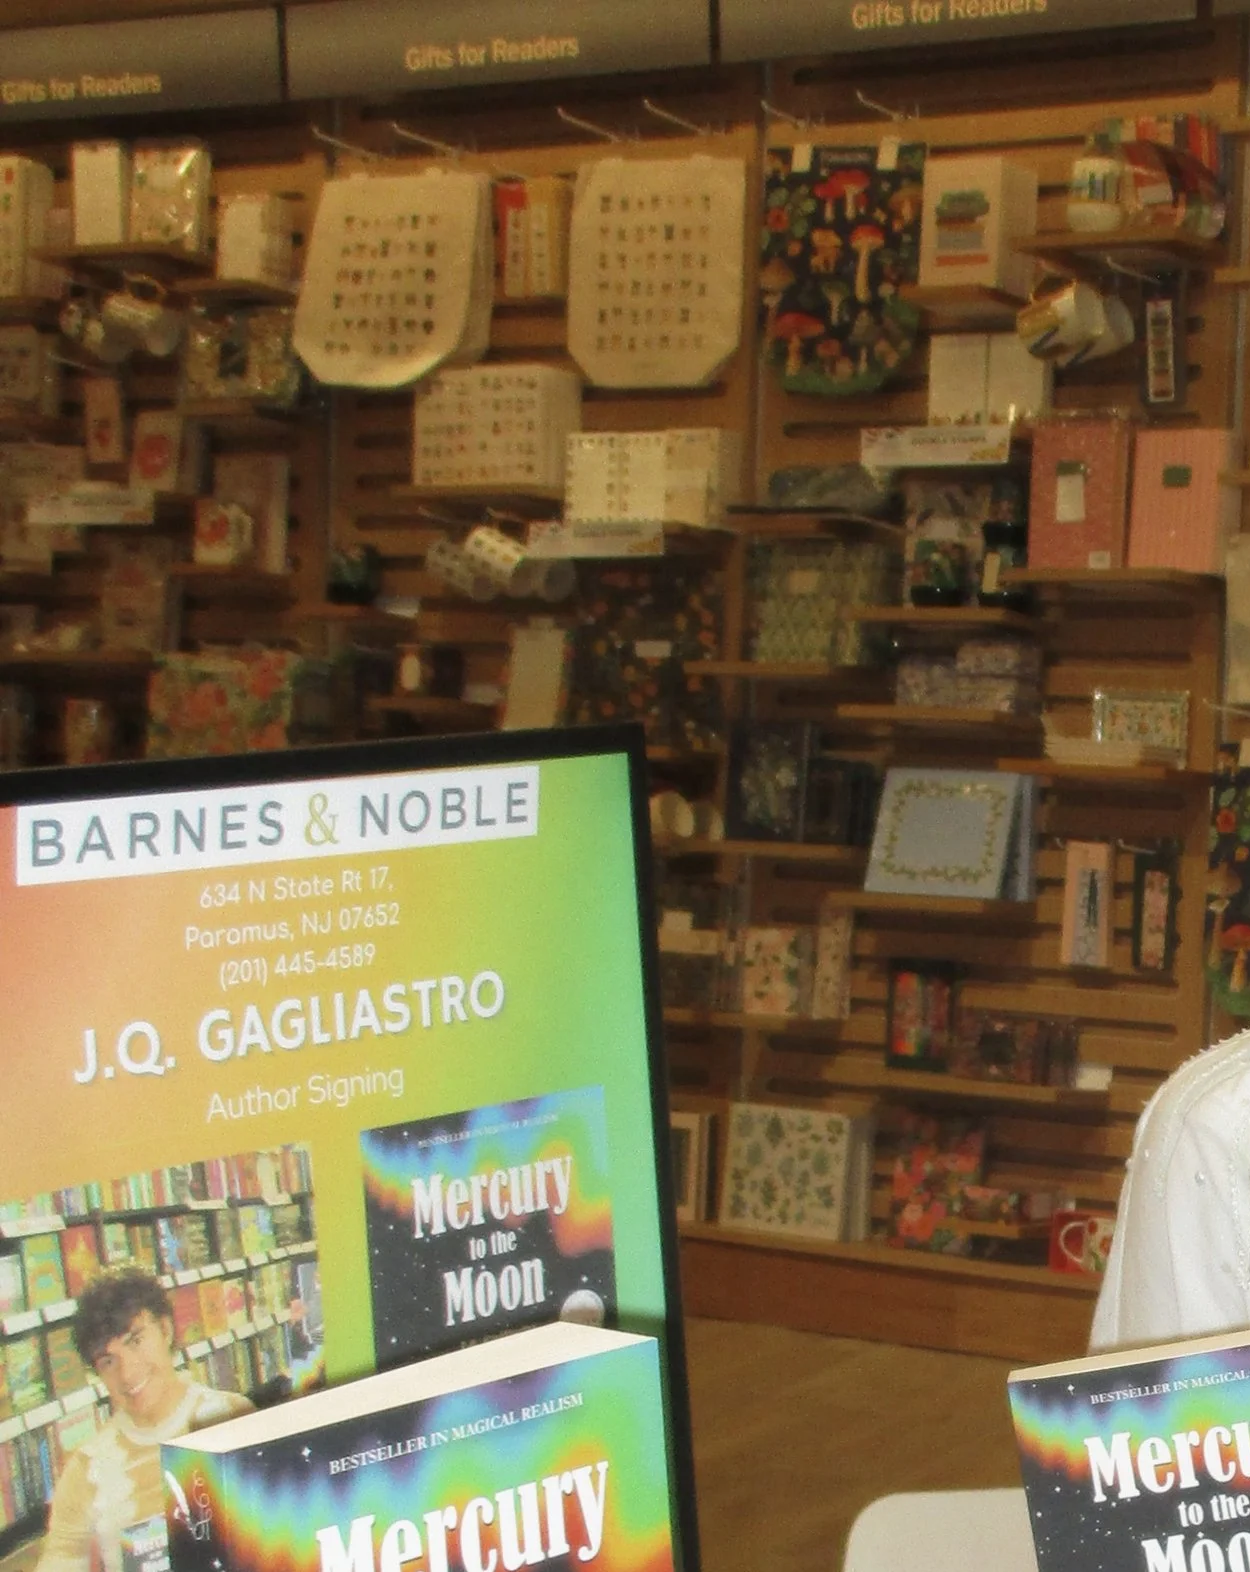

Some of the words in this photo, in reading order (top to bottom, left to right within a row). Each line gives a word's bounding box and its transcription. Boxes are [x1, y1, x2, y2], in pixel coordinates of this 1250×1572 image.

[852, 0, 904, 29] Gifts
[911, 0, 943, 24] for
[405, 46, 452, 72] Gifts
[458, 43, 485, 66] for
[492, 37, 579, 63] Readers
[1, 81, 46, 104] Gifts
[50, 79, 75, 101] for
[80, 73, 161, 99] Readers
[30, 801, 286, 868] BARNES
[303, 792, 340, 849] &
[358, 780, 531, 839] NOBLE
[199, 884, 241, 910] 634
[248, 879, 268, 904] N
[272, 872, 334, 902] State
[341, 867, 363, 894] Rt
[369, 865, 394, 893] 17,
[184, 918, 293, 951] Paramus,
[300, 911, 332, 937] NJ
[338, 902, 401, 932] 07652
[218, 959, 270, 992] (201)
[274, 943, 377, 978] 445-4589
[72, 1019, 177, 1086] J.Q.
[197, 968, 507, 1064] GAGLIASTRO
[205, 1081, 302, 1124] Author
[307, 1064, 405, 1107] Signing
[411, 1155, 573, 1240] Mercury
[469, 1236, 486, 1261] to
[491, 1230, 518, 1256] the
[443, 1258, 546, 1327] Moon
[1090, 1382, 1171, 1404] BESTSELLER
[1173, 1378, 1188, 1391] IN
[1191, 1368, 1249, 1390] MAGICAL
[330, 1436, 428, 1476] BESTSELLER
[430, 1427, 450, 1448] IN
[451, 1410, 520, 1442] MAGICAL
[521, 1392, 584, 1423] REALISM
[1178, 1500, 1205, 1527] to
